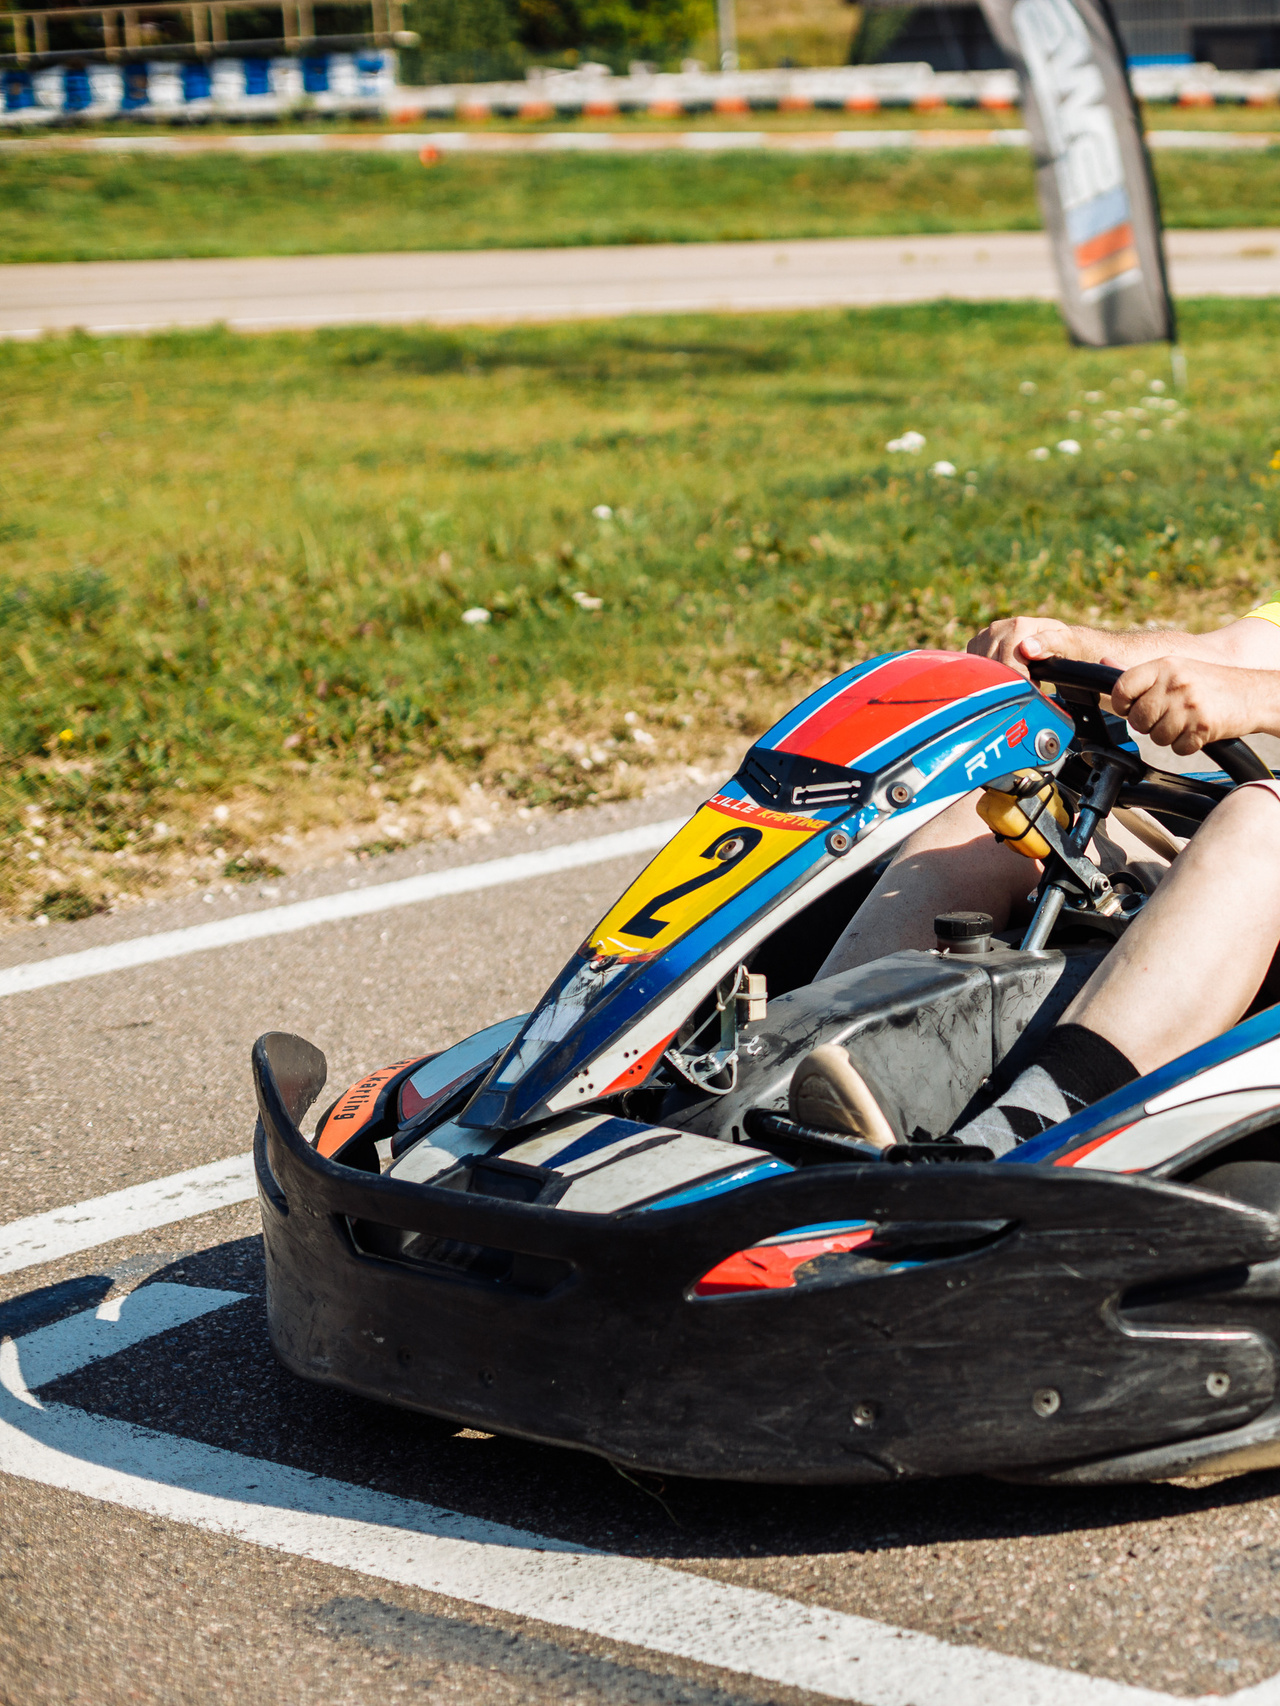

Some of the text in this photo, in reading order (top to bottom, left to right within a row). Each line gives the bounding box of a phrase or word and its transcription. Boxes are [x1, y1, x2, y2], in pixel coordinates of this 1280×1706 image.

[964, 718, 1029, 781] RT8
[709, 793, 829, 829] LILLE KARTING
[618, 826, 763, 940] 2
